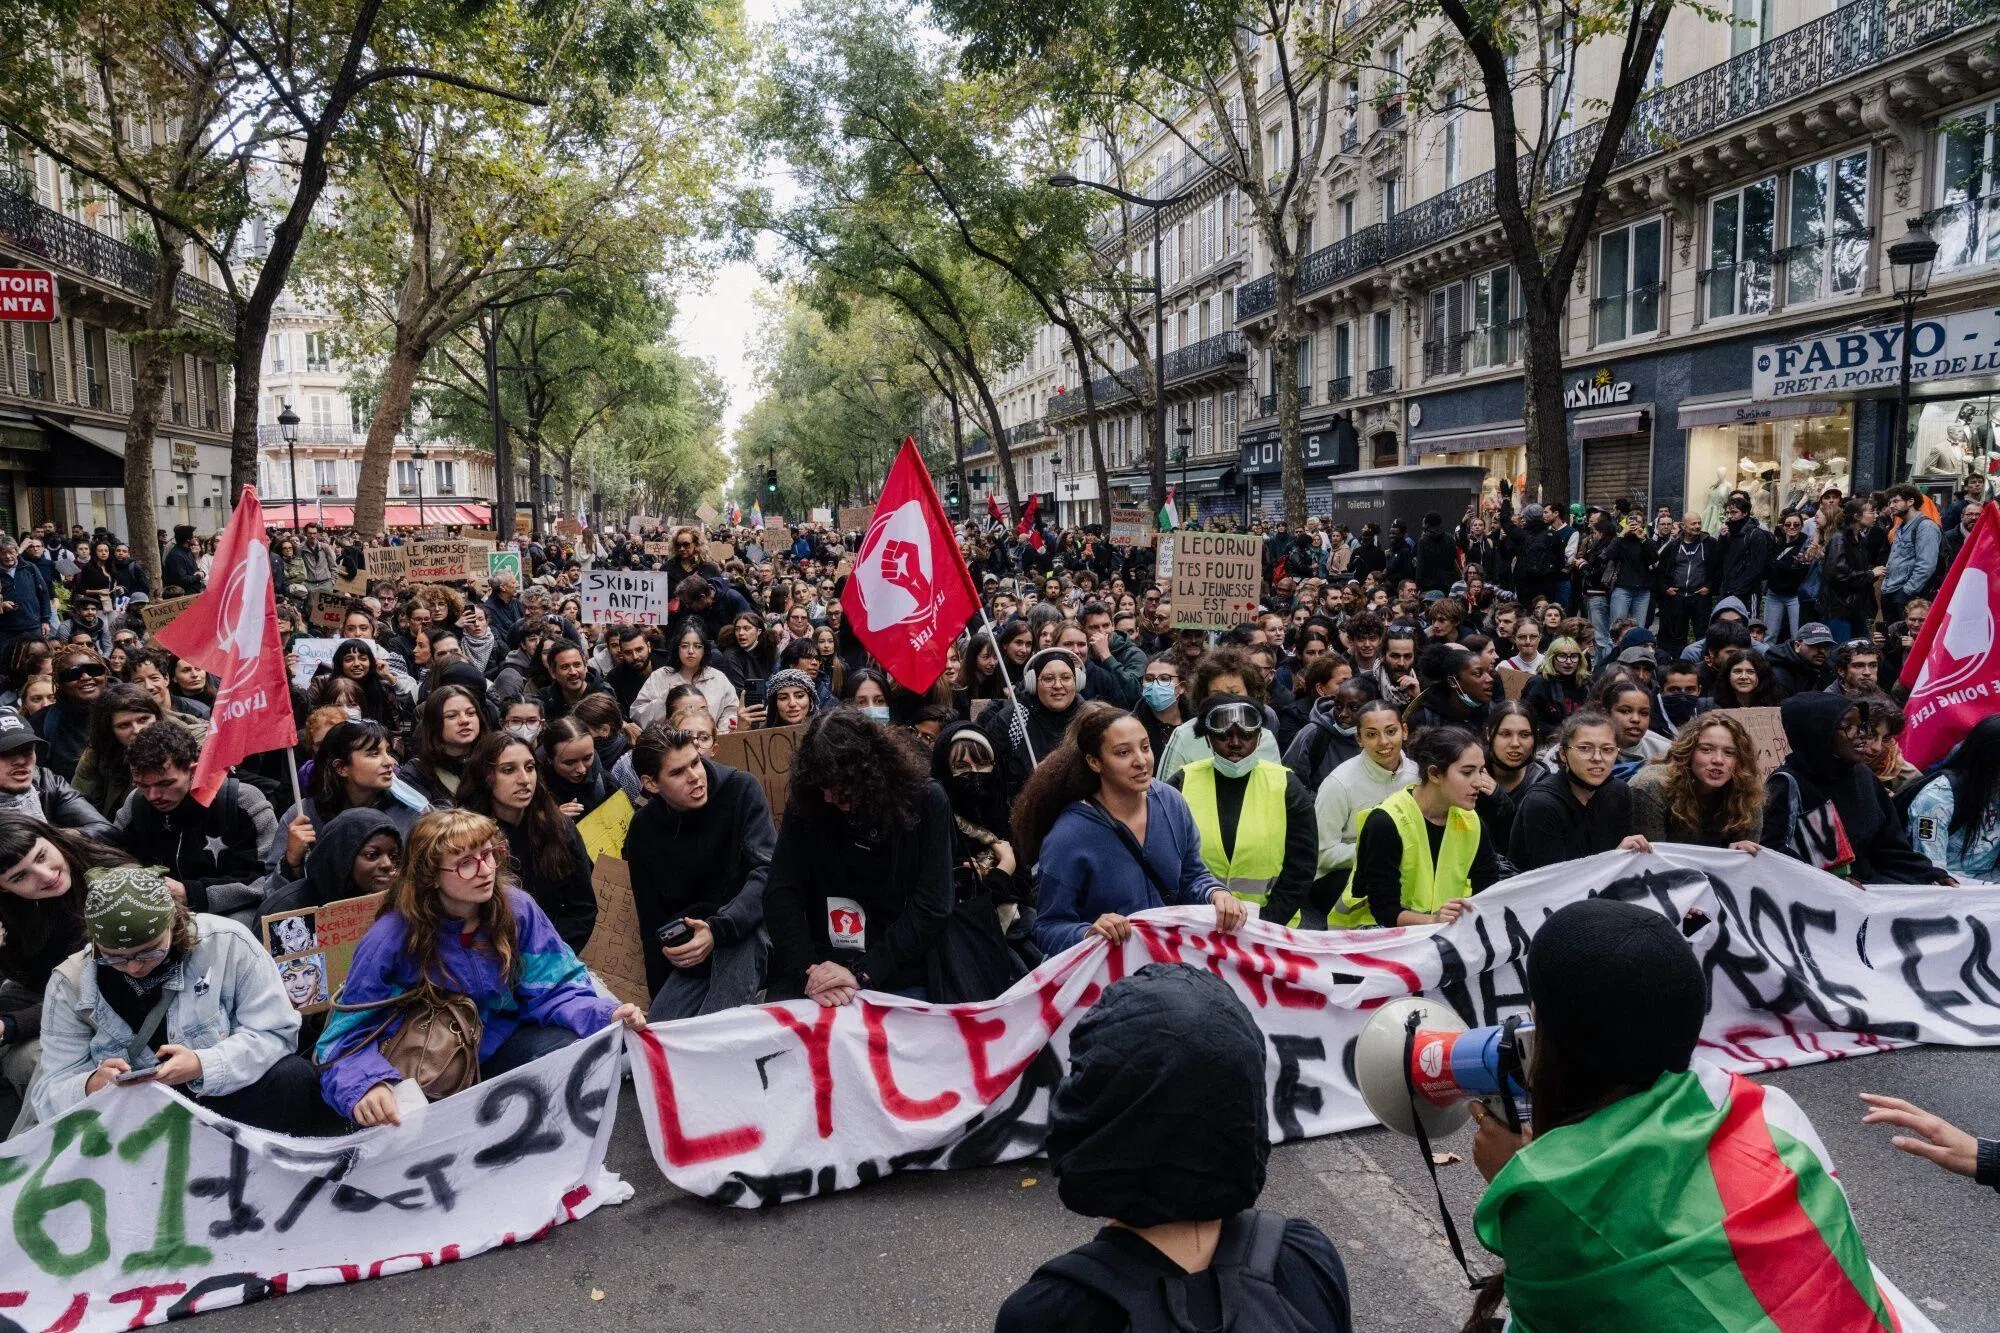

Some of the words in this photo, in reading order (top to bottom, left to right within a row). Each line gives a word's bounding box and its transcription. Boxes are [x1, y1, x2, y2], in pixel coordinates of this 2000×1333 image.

[0, 297, 46, 312] NTA
[1775, 322, 1946, 377] FABYO
[1773, 376, 1822, 396] PRET
[1824, 374, 1838, 389] A
[1842, 362, 1928, 388] PORTR
[1932, 357, 1967, 376] DE
[406, 545, 420, 556] LE
[422, 544, 451, 555] PARDON
[1181, 536, 1256, 557] LECORNU
[1177, 562, 1201, 577] T'ES
[1205, 562, 1254, 580] FOUTU
[1179, 580, 1195, 596] LA
[1199, 581, 1255, 598] JEUNESSE
[146, 604, 175, 617] TAXER
[1203, 598, 1227, 611] EST
[1177, 610, 1203, 624] DANS
[1207, 612, 1229, 625] TON
